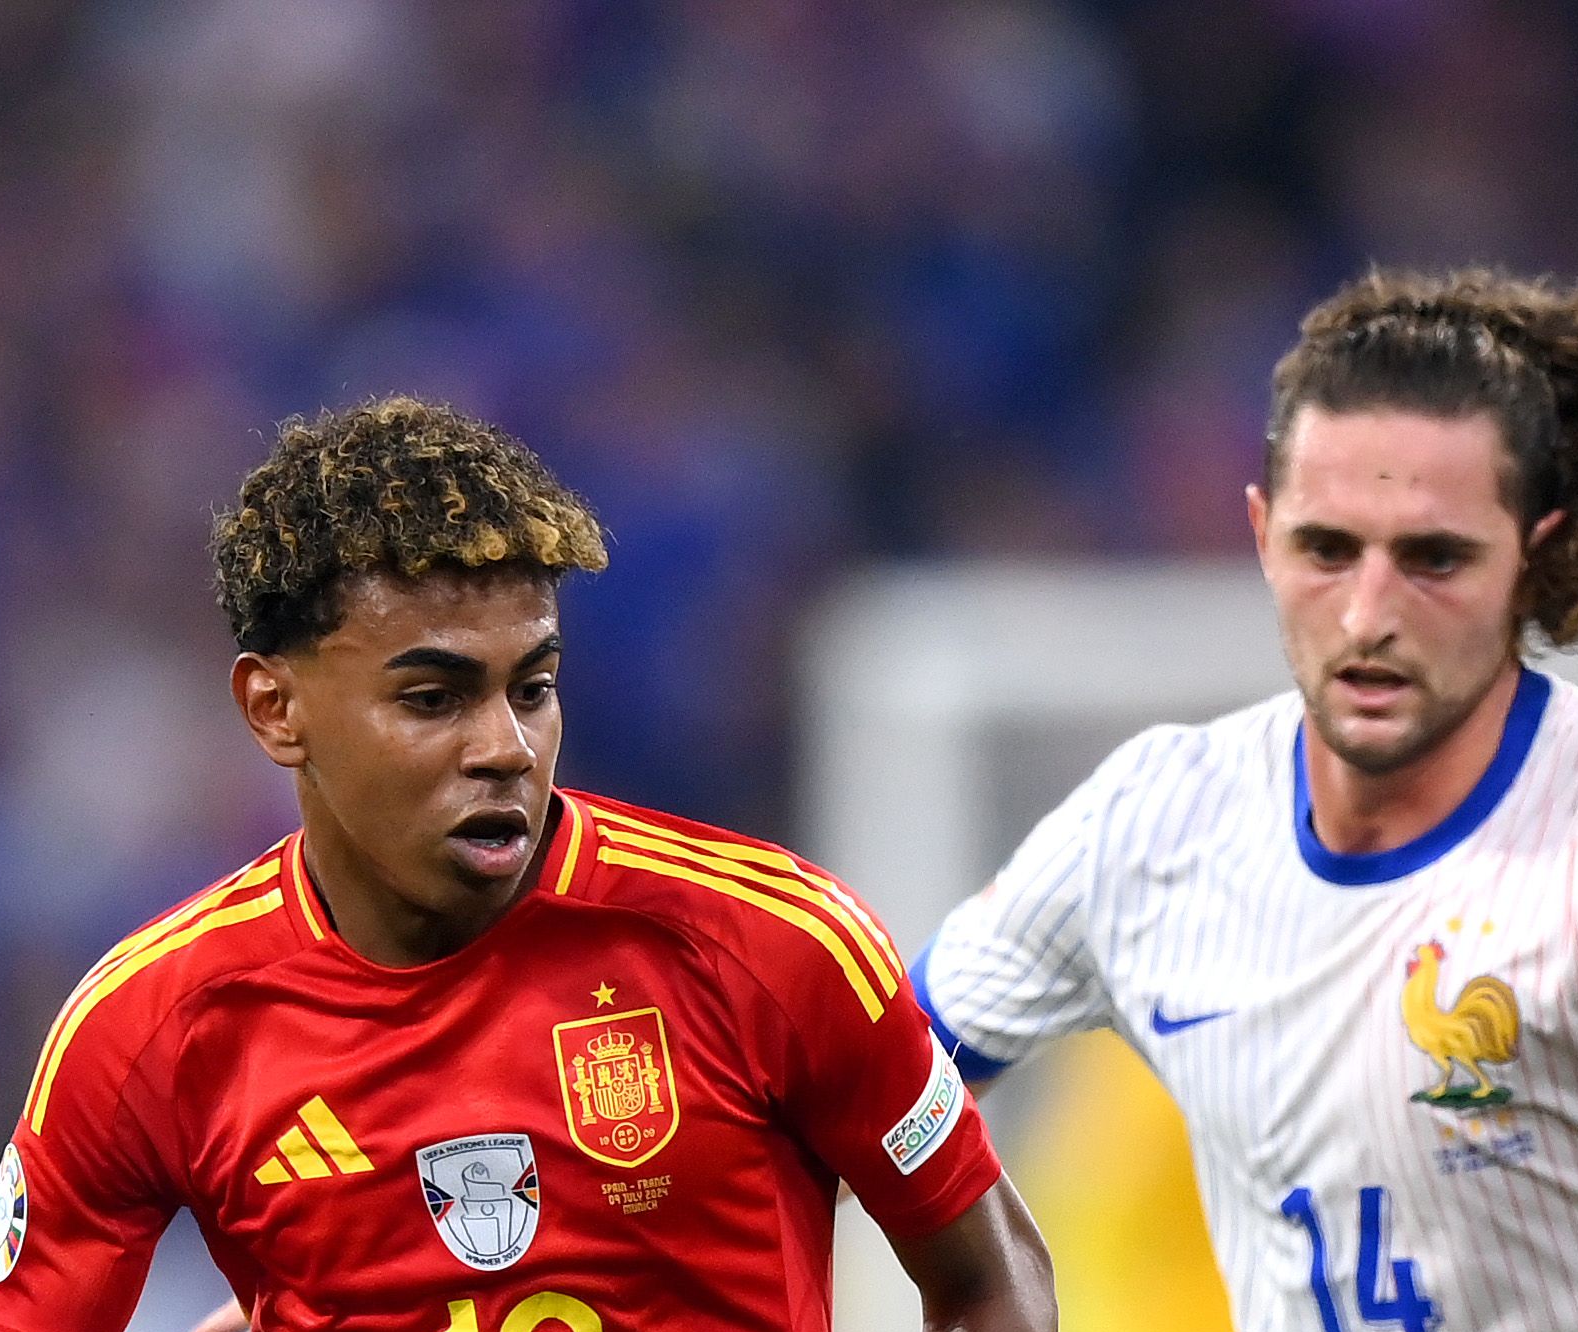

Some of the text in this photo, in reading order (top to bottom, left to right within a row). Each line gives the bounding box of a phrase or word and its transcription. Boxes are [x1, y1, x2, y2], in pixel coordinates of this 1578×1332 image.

[886, 1118, 917, 1148] UEFA
[423, 1139, 525, 1160] UEFA NATIONS LEAGUE
[601, 1182, 628, 1195] SPAIN
[637, 1175, 672, 1190] FRANCE
[608, 1188, 669, 1206] 09 JULY 2024
[623, 1200, 658, 1215] MUNICH
[465, 1252, 501, 1266] WINNER
